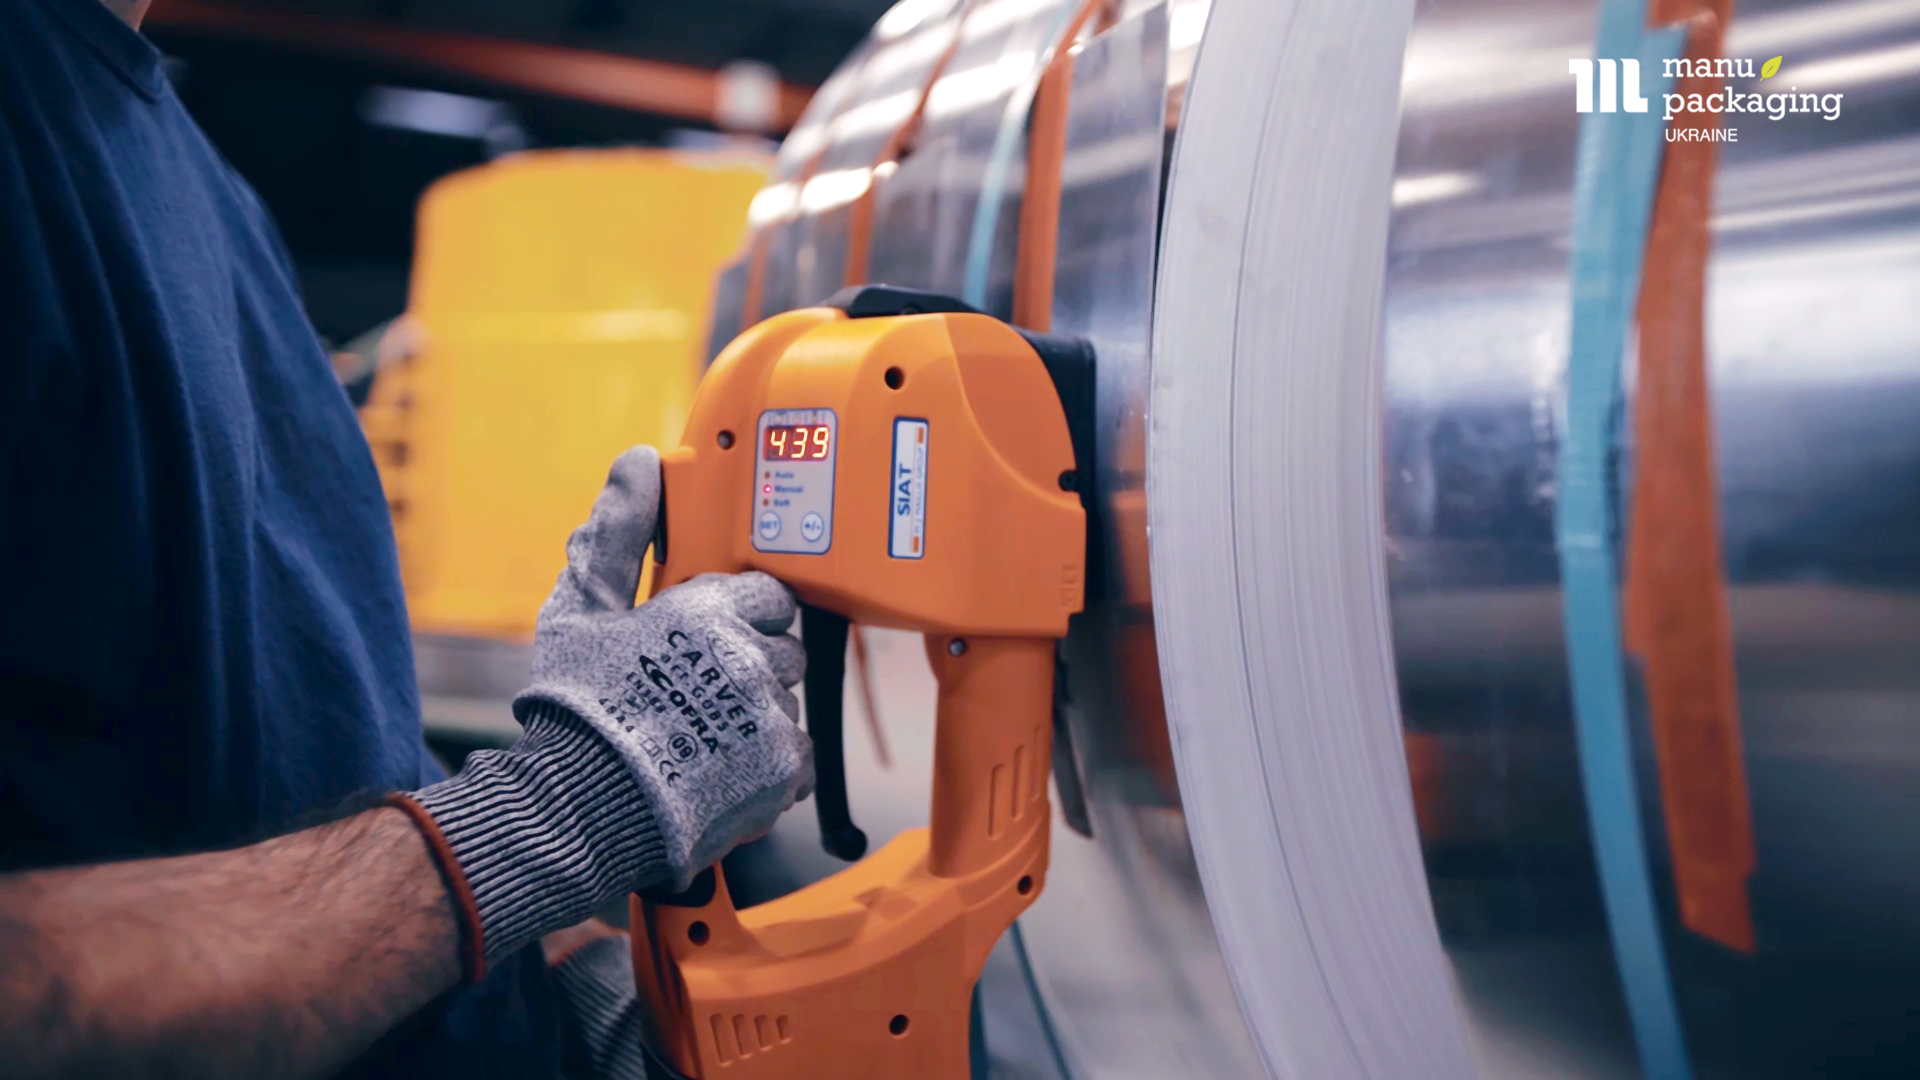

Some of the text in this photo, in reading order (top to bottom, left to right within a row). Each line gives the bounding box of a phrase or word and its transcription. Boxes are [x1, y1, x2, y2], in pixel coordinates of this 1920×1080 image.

[770, 427, 829, 459] 439
[774, 484, 804, 493] Manual
[897, 462, 912, 517] SIAT
[639, 655, 719, 754] COFRA
[667, 630, 758, 738] CARVER
